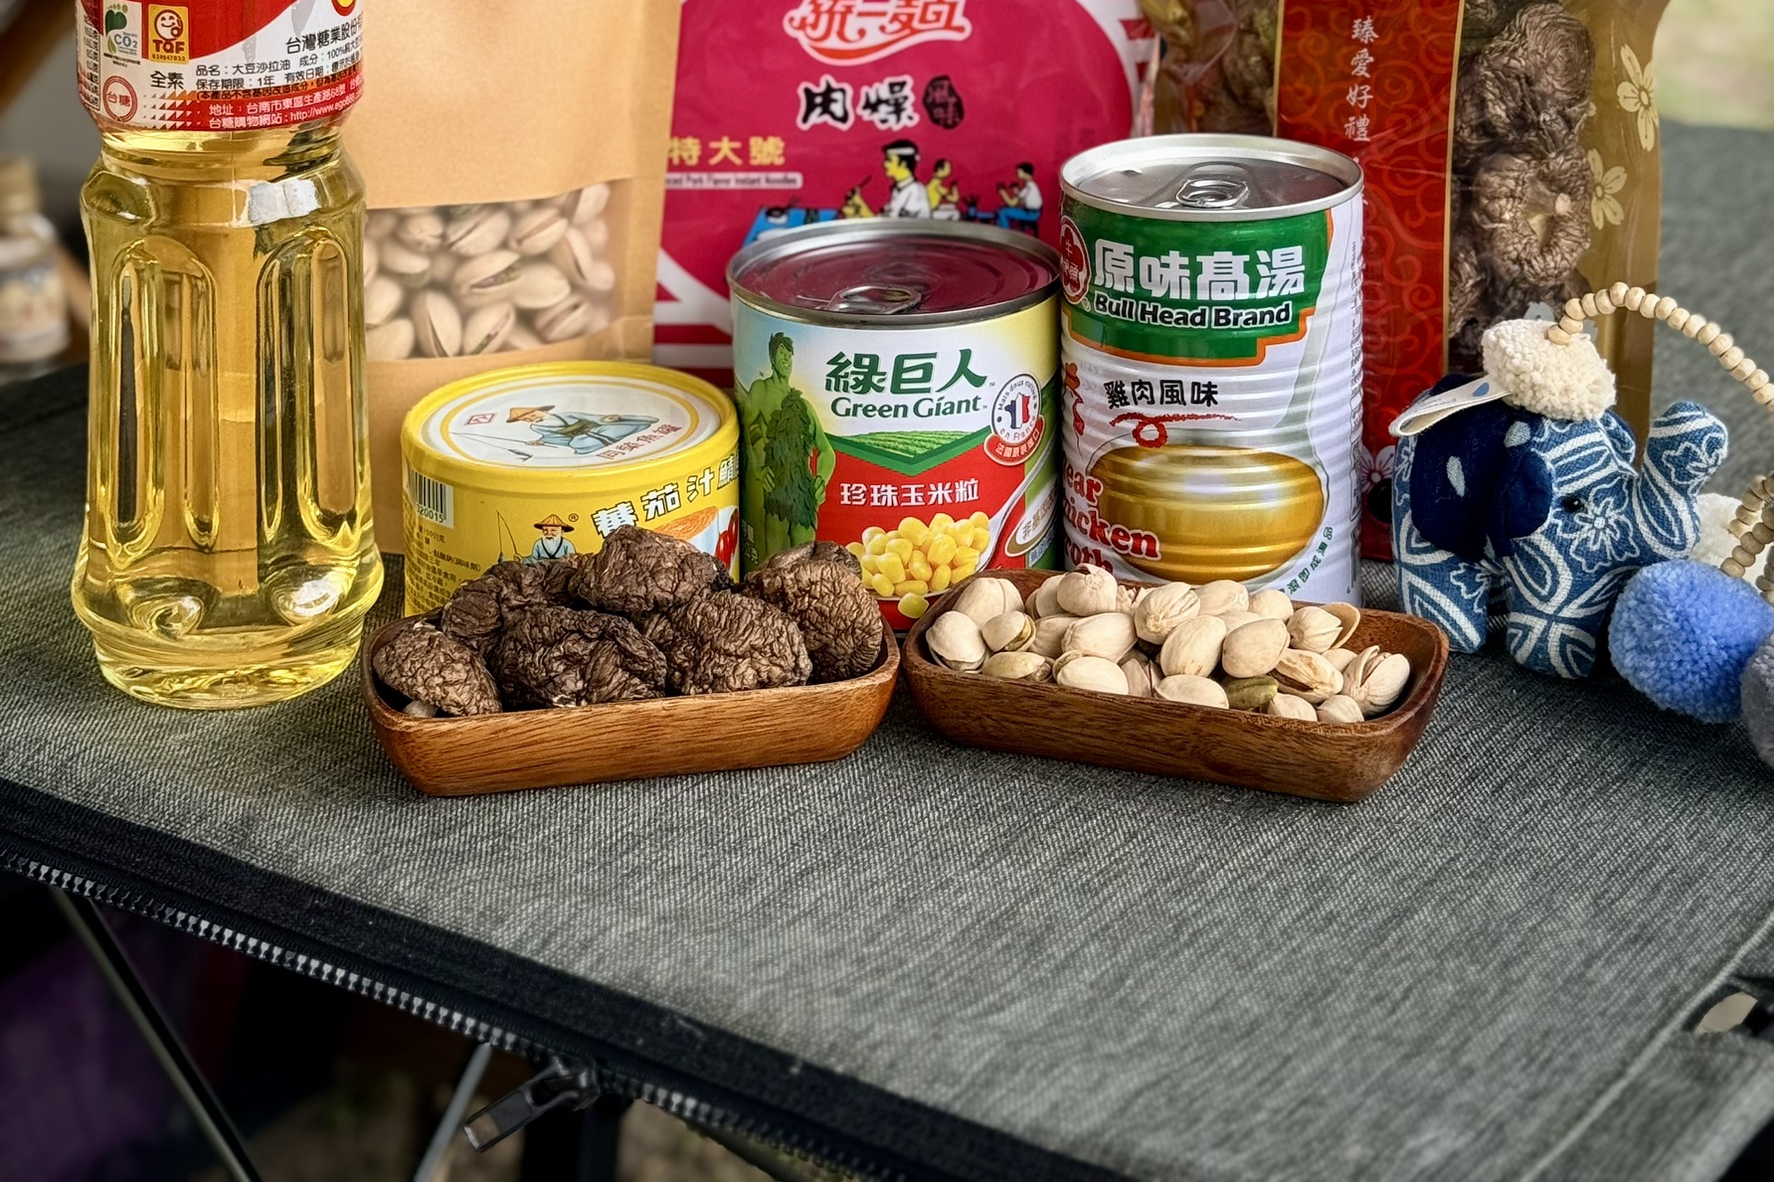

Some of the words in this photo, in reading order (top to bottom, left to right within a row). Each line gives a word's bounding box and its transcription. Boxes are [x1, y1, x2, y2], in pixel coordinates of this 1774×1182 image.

[152, 39, 185, 54] TQF
[150, 70, 184, 90] 全素
[1344, 15, 1379, 142] 臻愛好禮
[107, 91, 131, 107] 台糖
[668, 135, 785, 166] 特大號
[1095, 294, 1135, 321] Bull
[1139, 303, 1207, 327] Head
[1213, 303, 1291, 327] Brand
[825, 348, 987, 395] 綠巨人
[831, 398, 908, 418] Green
[913, 394, 982, 418] Giant
[1104, 379, 1219, 410] 雞肉風味
[590, 452, 739, 538] 蕃茄汁鯖
[840, 478, 979, 507] 珍珠玉米粒
